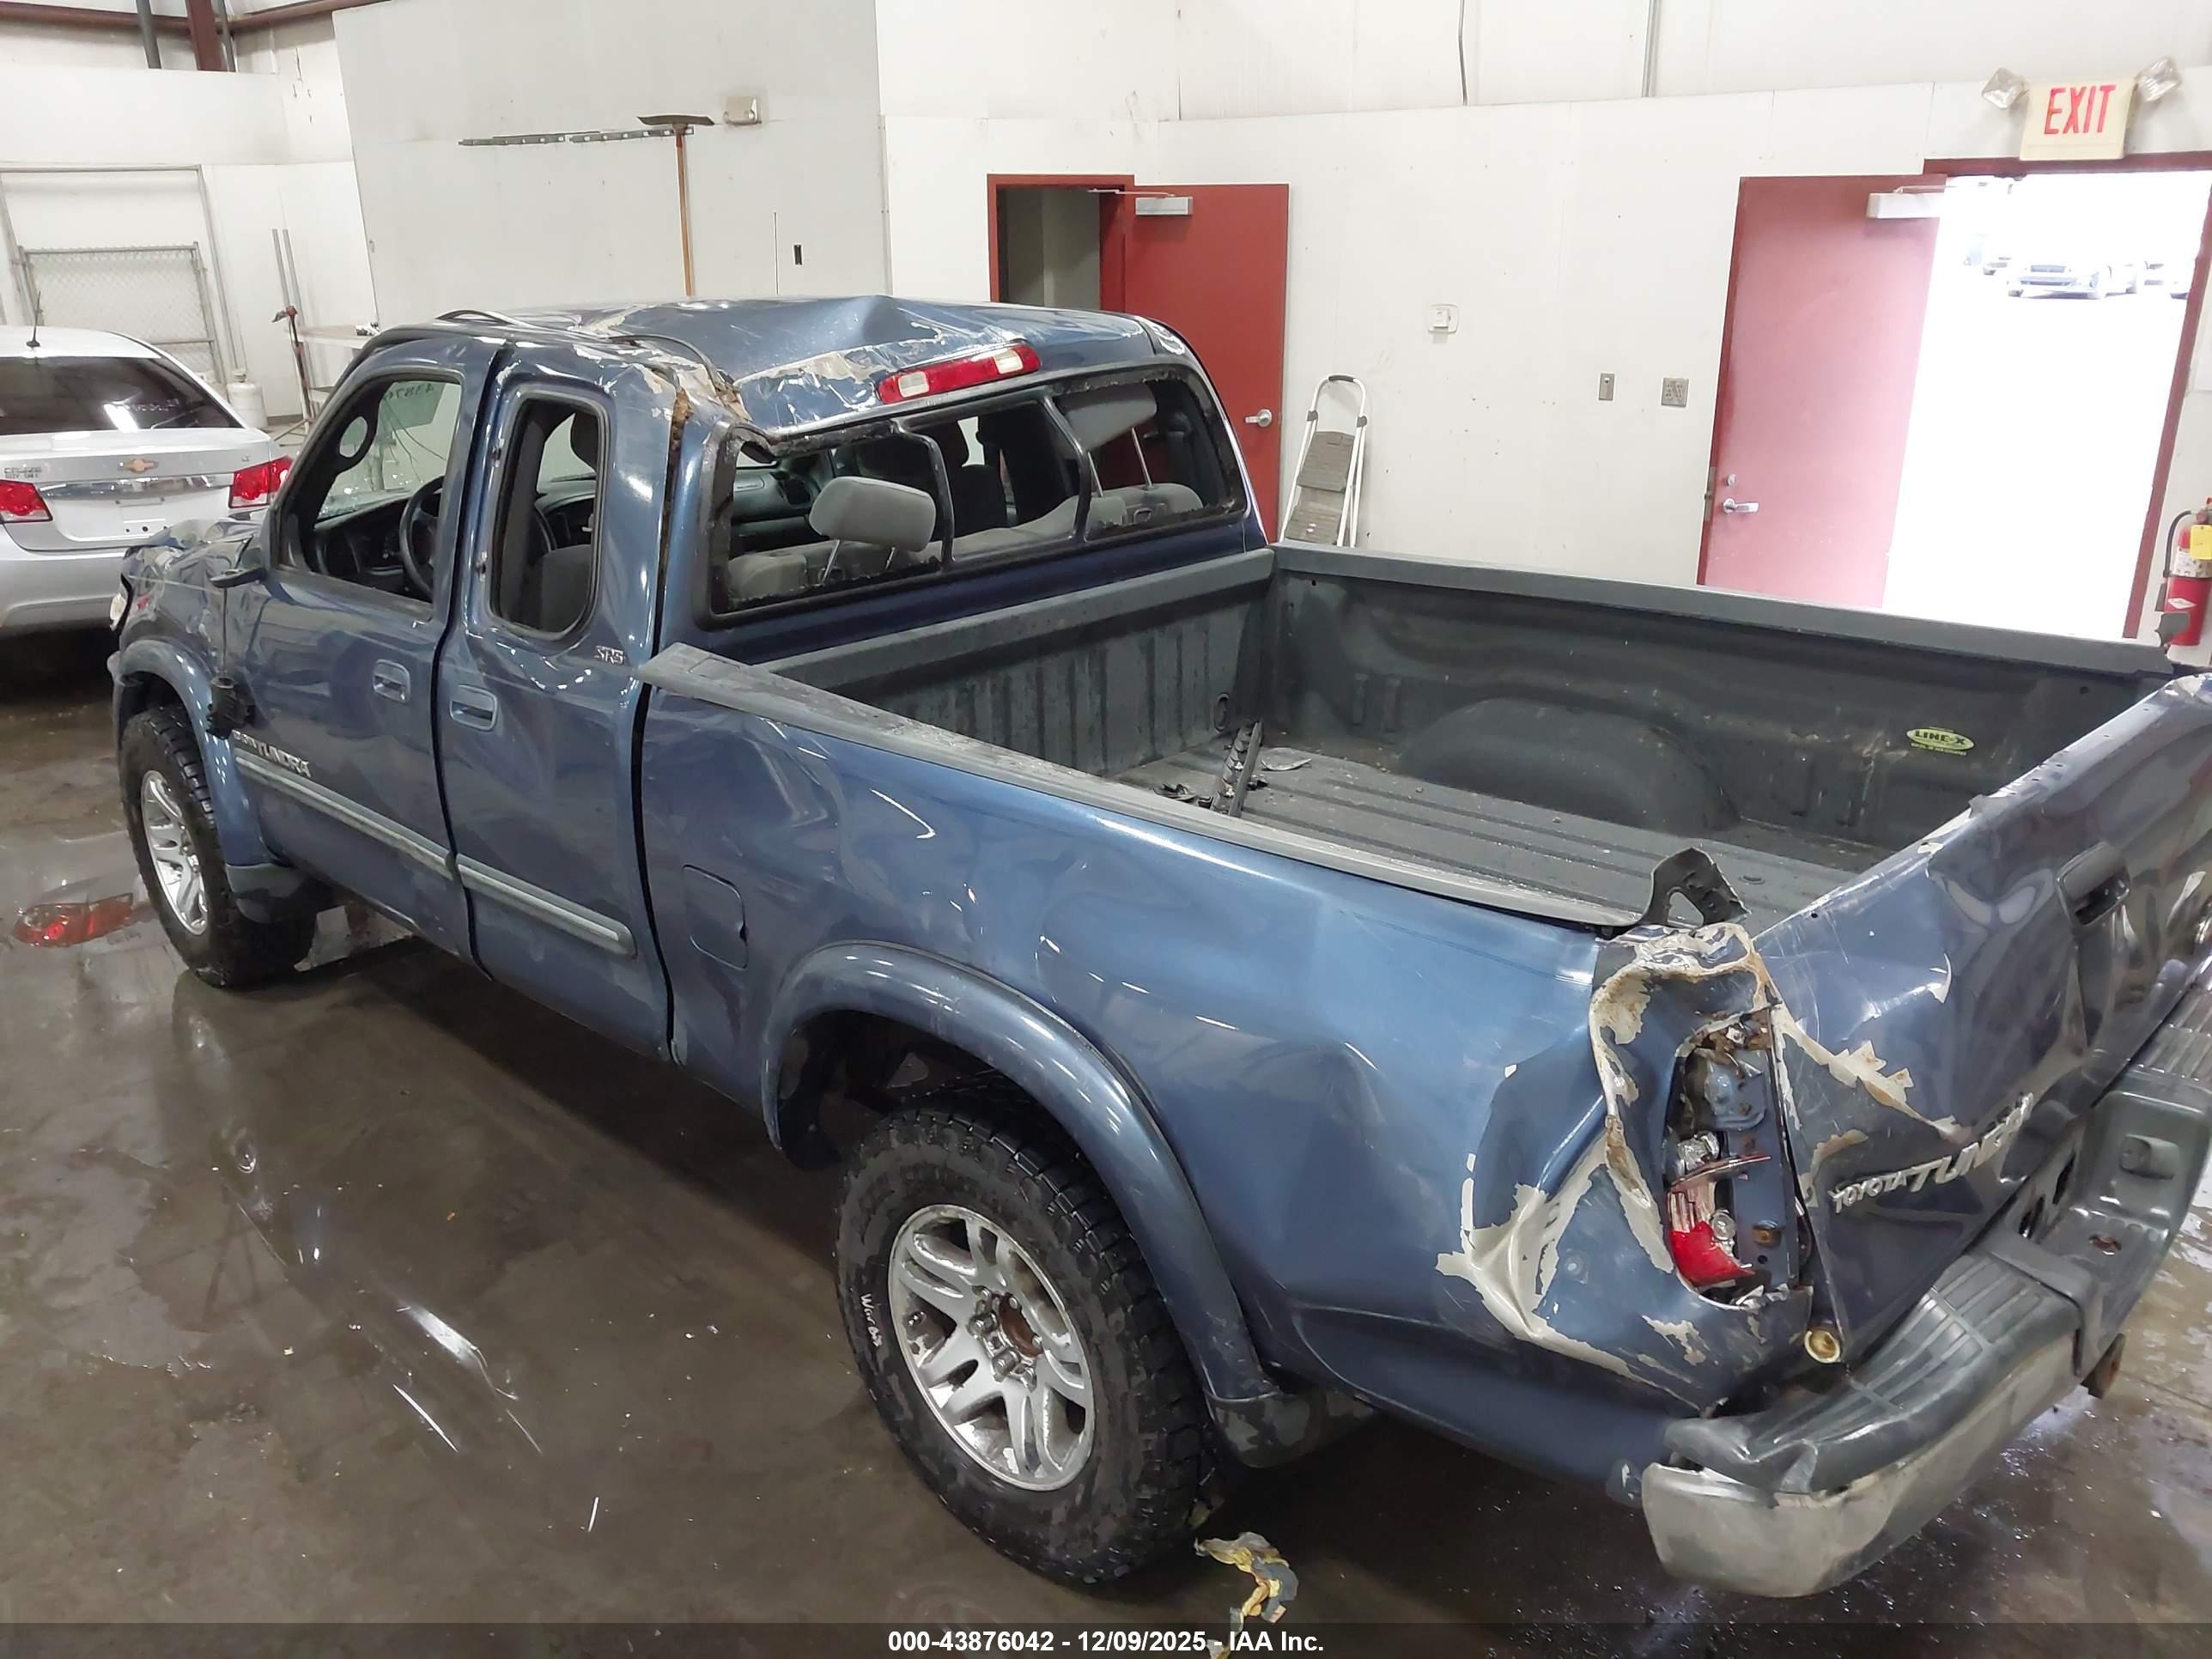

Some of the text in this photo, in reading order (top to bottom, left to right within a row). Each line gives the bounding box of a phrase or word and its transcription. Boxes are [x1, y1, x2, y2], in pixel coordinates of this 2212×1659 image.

[2044, 84, 2117, 135] EXIT
[258, 742, 311, 778] TUNDRA
[1827, 1170, 1907, 1213] TOYOTA
